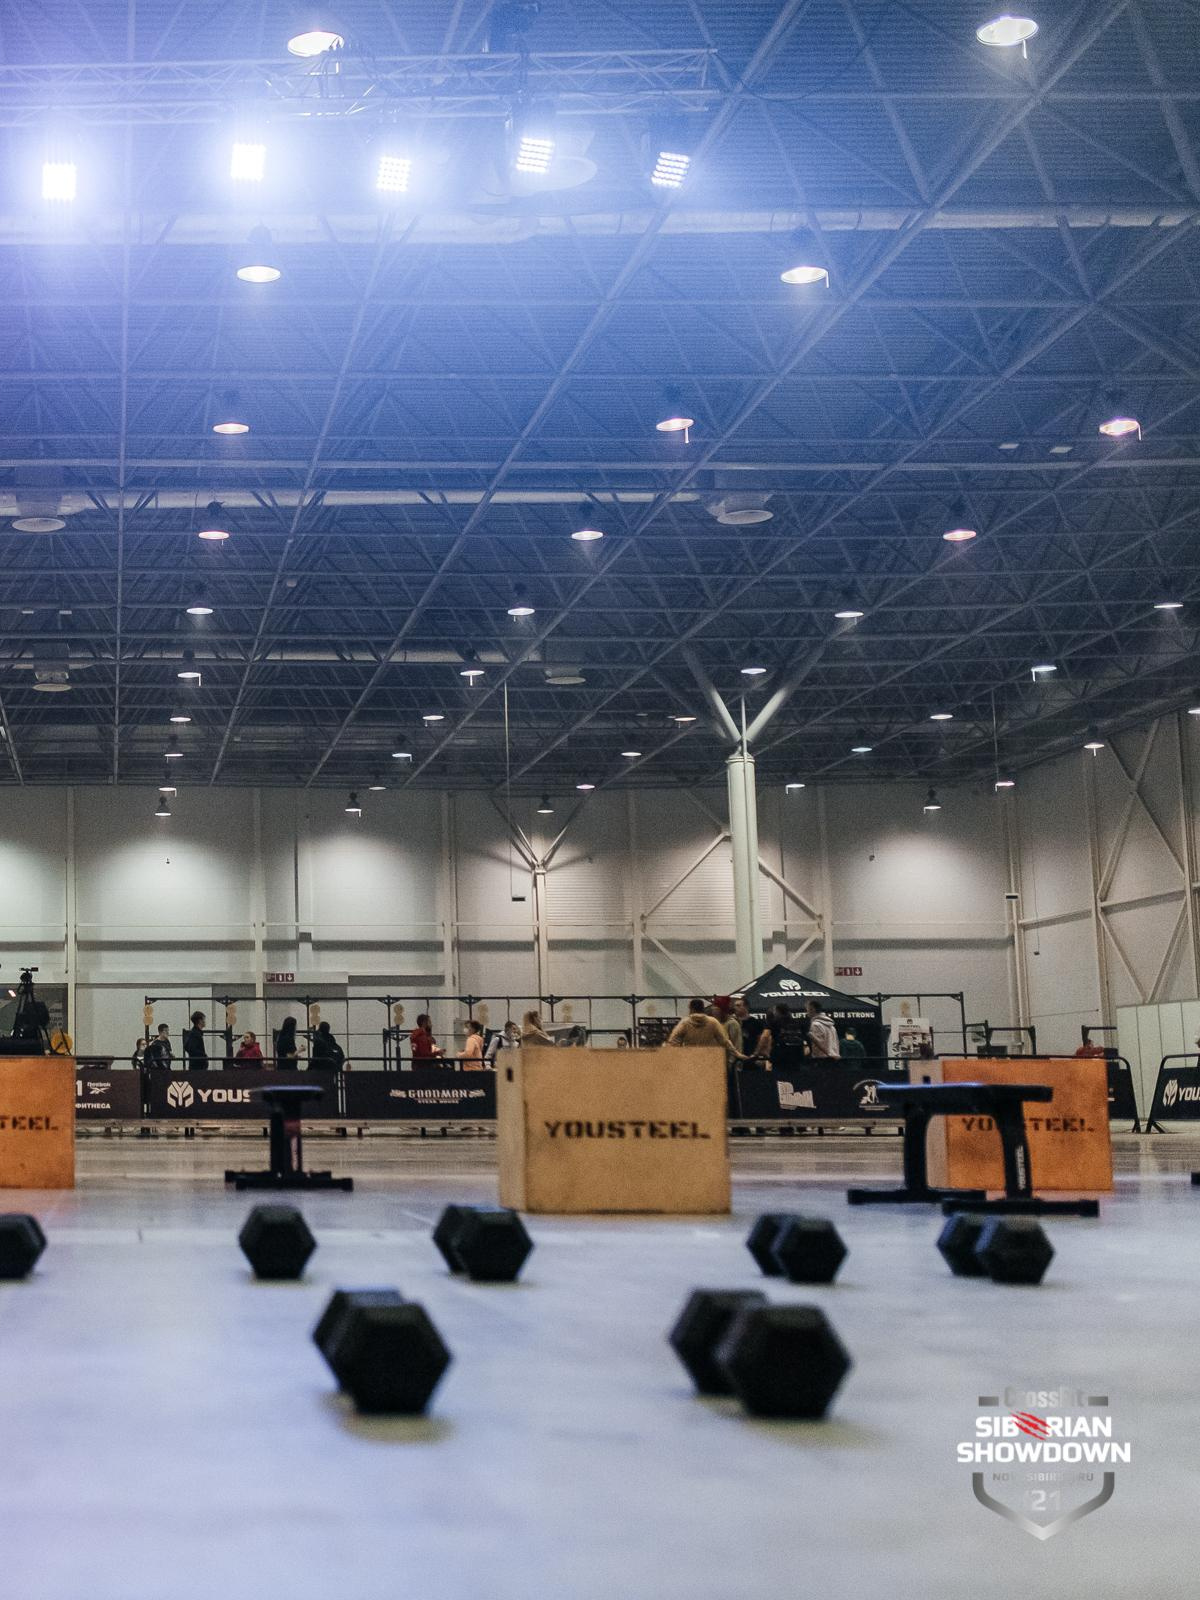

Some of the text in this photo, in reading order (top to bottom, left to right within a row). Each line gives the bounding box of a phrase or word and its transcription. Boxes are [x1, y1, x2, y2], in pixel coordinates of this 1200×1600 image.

[760, 990, 830, 998] YOUSTEEL
[847, 1011, 875, 1019] STRONG
[407, 1089, 468, 1098] GOODMAN
[961, 1117, 1096, 1132] YOTEEL
[544, 1120, 711, 1139] YOUSTEEL
